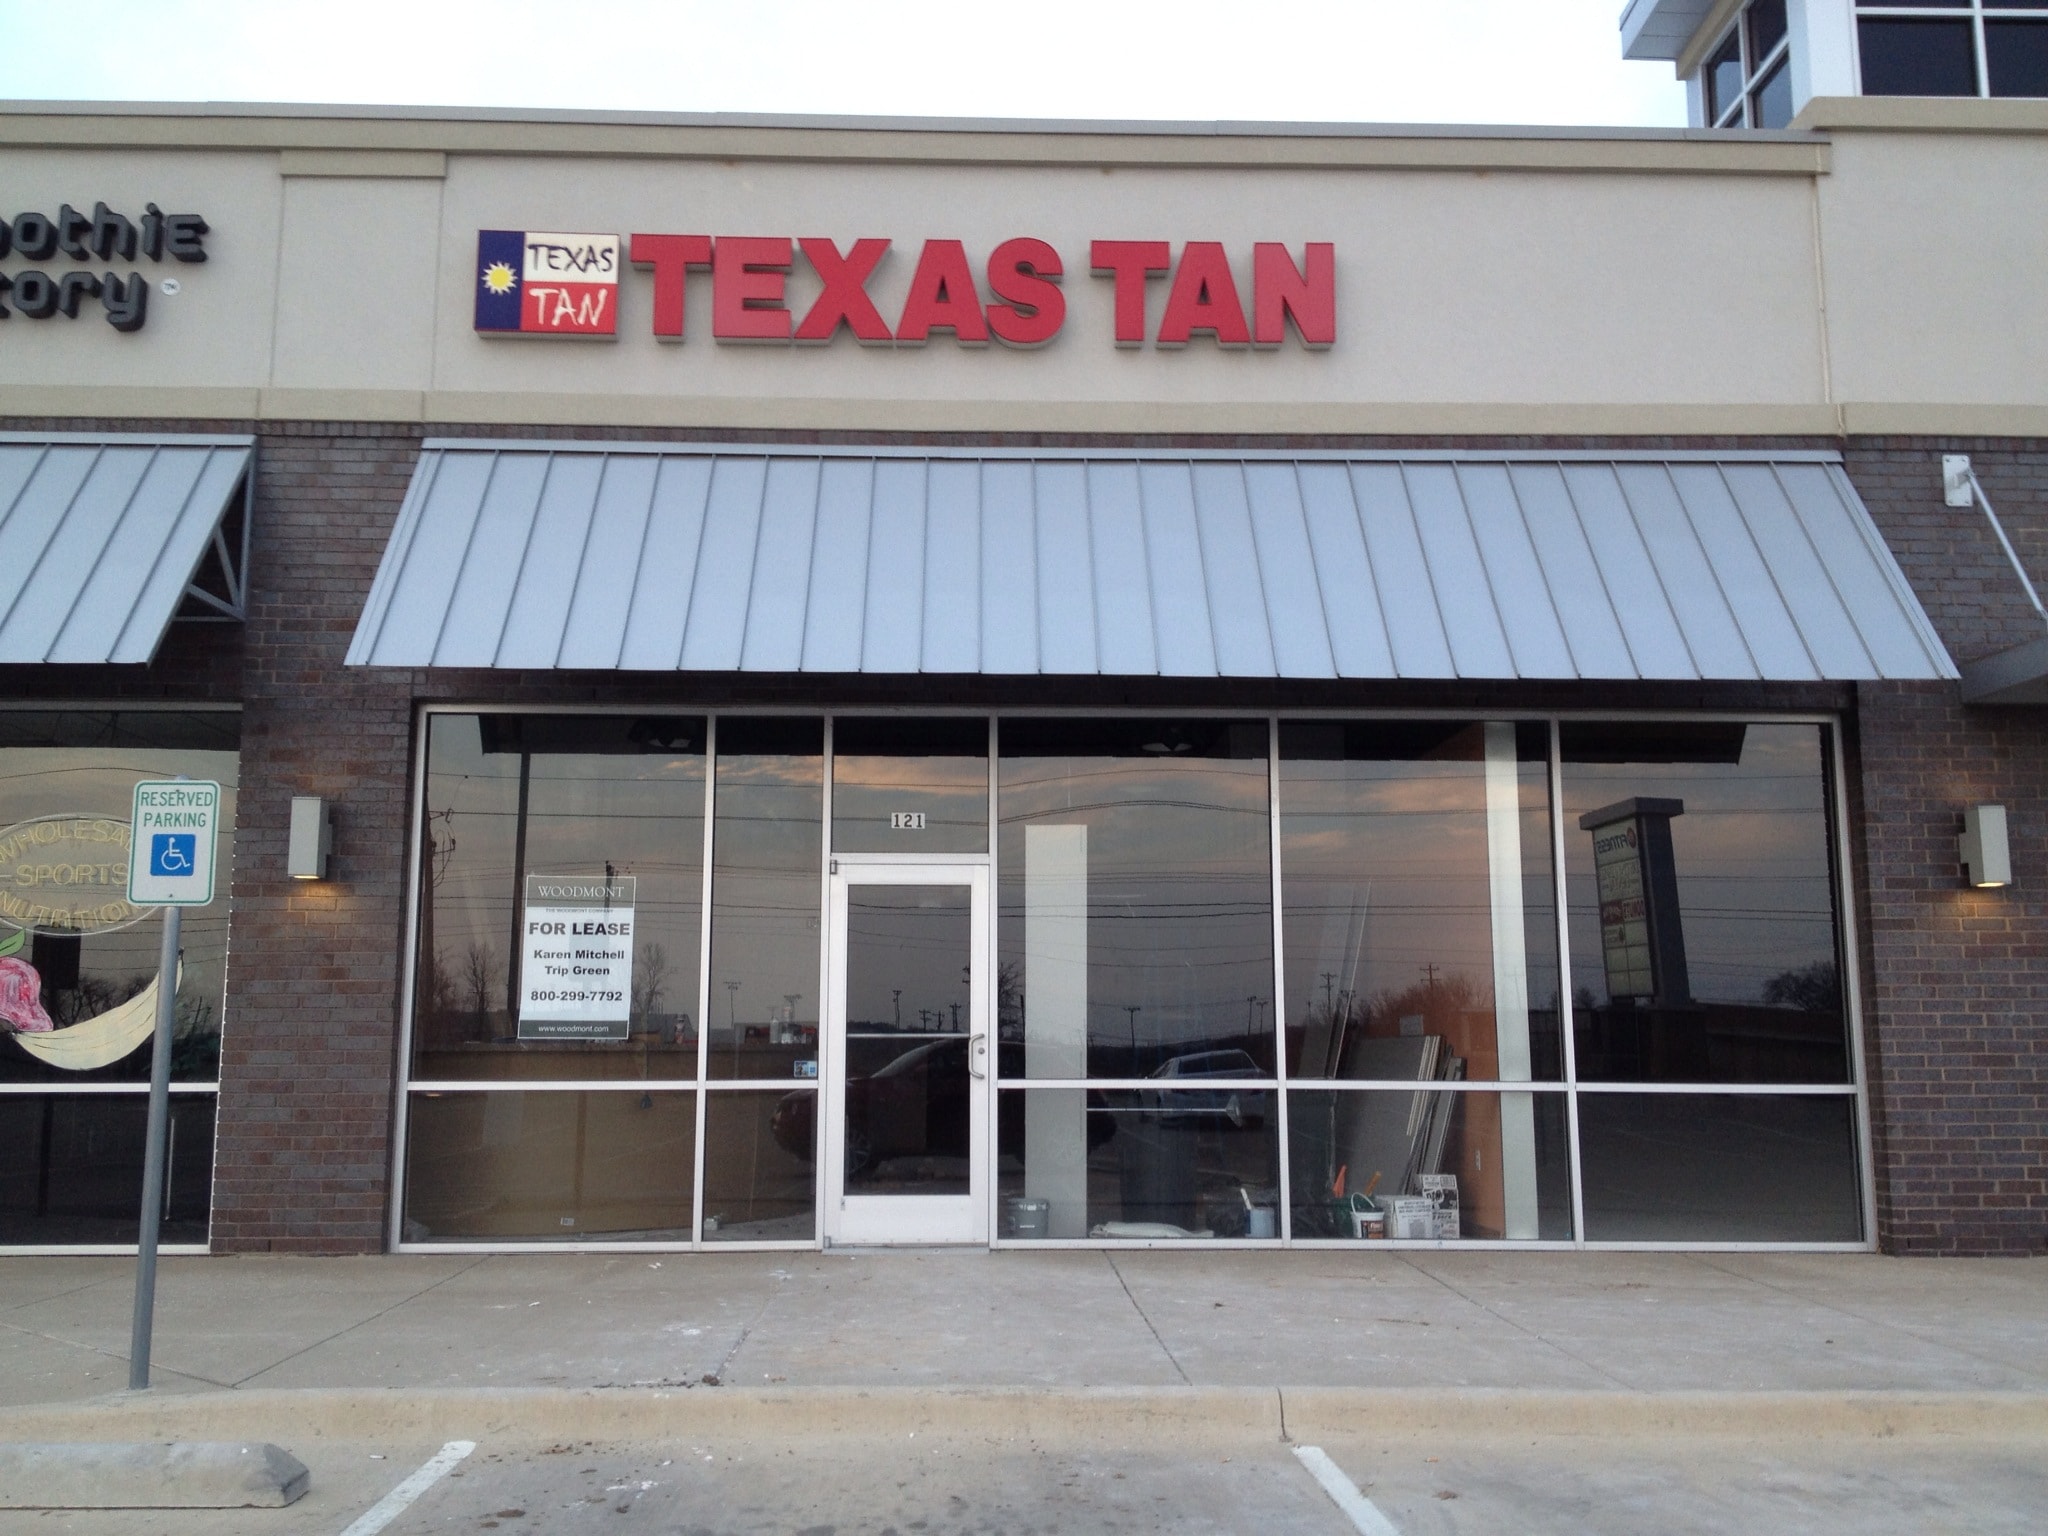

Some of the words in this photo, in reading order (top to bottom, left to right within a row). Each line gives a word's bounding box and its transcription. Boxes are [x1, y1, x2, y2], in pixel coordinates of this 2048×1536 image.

[0, 201, 209, 262] othie
[528, 243, 614, 273] TEXAS
[629, 233, 1067, 349] TEXAS
[1090, 239, 1336, 351] TAN
[0, 270, 148, 332] ory
[528, 287, 608, 327] TAN
[140, 791, 213, 807] RESERVED
[143, 812, 207, 828] PARKING
[893, 813, 923, 828] 121
[16, 863, 130, 886] SPORTS
[538, 885, 625, 898] WOODMONT
[529, 922, 566, 935] FOR
[572, 922, 630, 936] LEASE
[533, 949, 571, 959] Karen
[575, 950, 625, 960] Mitchell
[545, 965, 569, 977] Trip
[572, 965, 610, 975] Green
[530, 990, 623, 1001] 800-299-7792
[538, 1024, 609, 1033] www.woodmont.com
